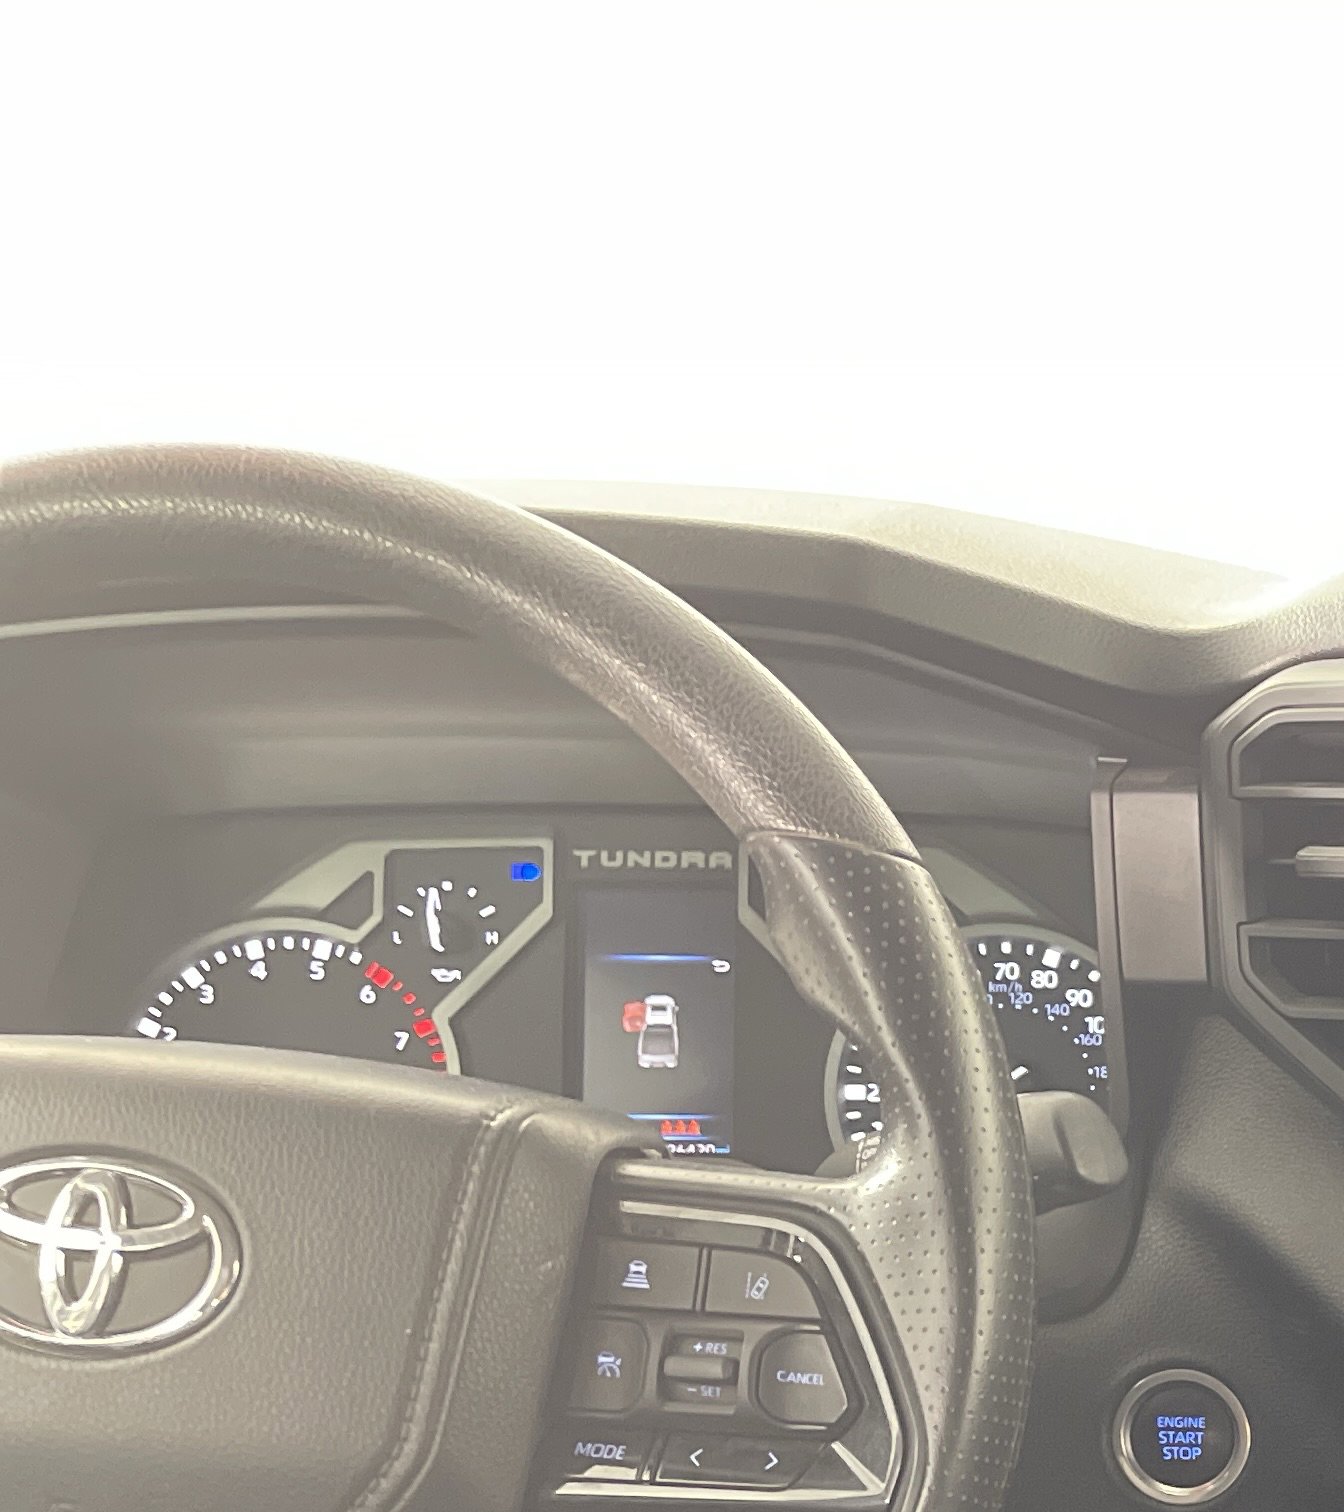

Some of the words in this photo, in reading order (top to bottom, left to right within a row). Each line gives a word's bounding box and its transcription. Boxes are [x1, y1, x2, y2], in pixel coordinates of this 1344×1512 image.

[572, 849, 733, 869] TUNDRA
[309, 960, 326, 981] 5
[993, 961, 1021, 981] 70
[1030, 969, 1059, 989] 80
[199, 983, 215, 1005] 3
[358, 984, 376, 1005] 6
[987, 980, 1023, 993] km/h
[1008, 991, 1033, 1005] 120
[1064, 988, 1094, 1008] 90
[1044, 1003, 1071, 1016] 140
[393, 1030, 410, 1052] 7
[1078, 1033, 1103, 1046] 160
[705, 1342, 728, 1356] RES
[775, 1369, 825, 1387] CANCEL
[700, 1385, 722, 1398] SET
[1156, 1415, 1207, 1429] ENGINE
[1157, 1430, 1205, 1445] START
[573, 1441, 627, 1461] MODE
[1162, 1446, 1202, 1461] STOP
